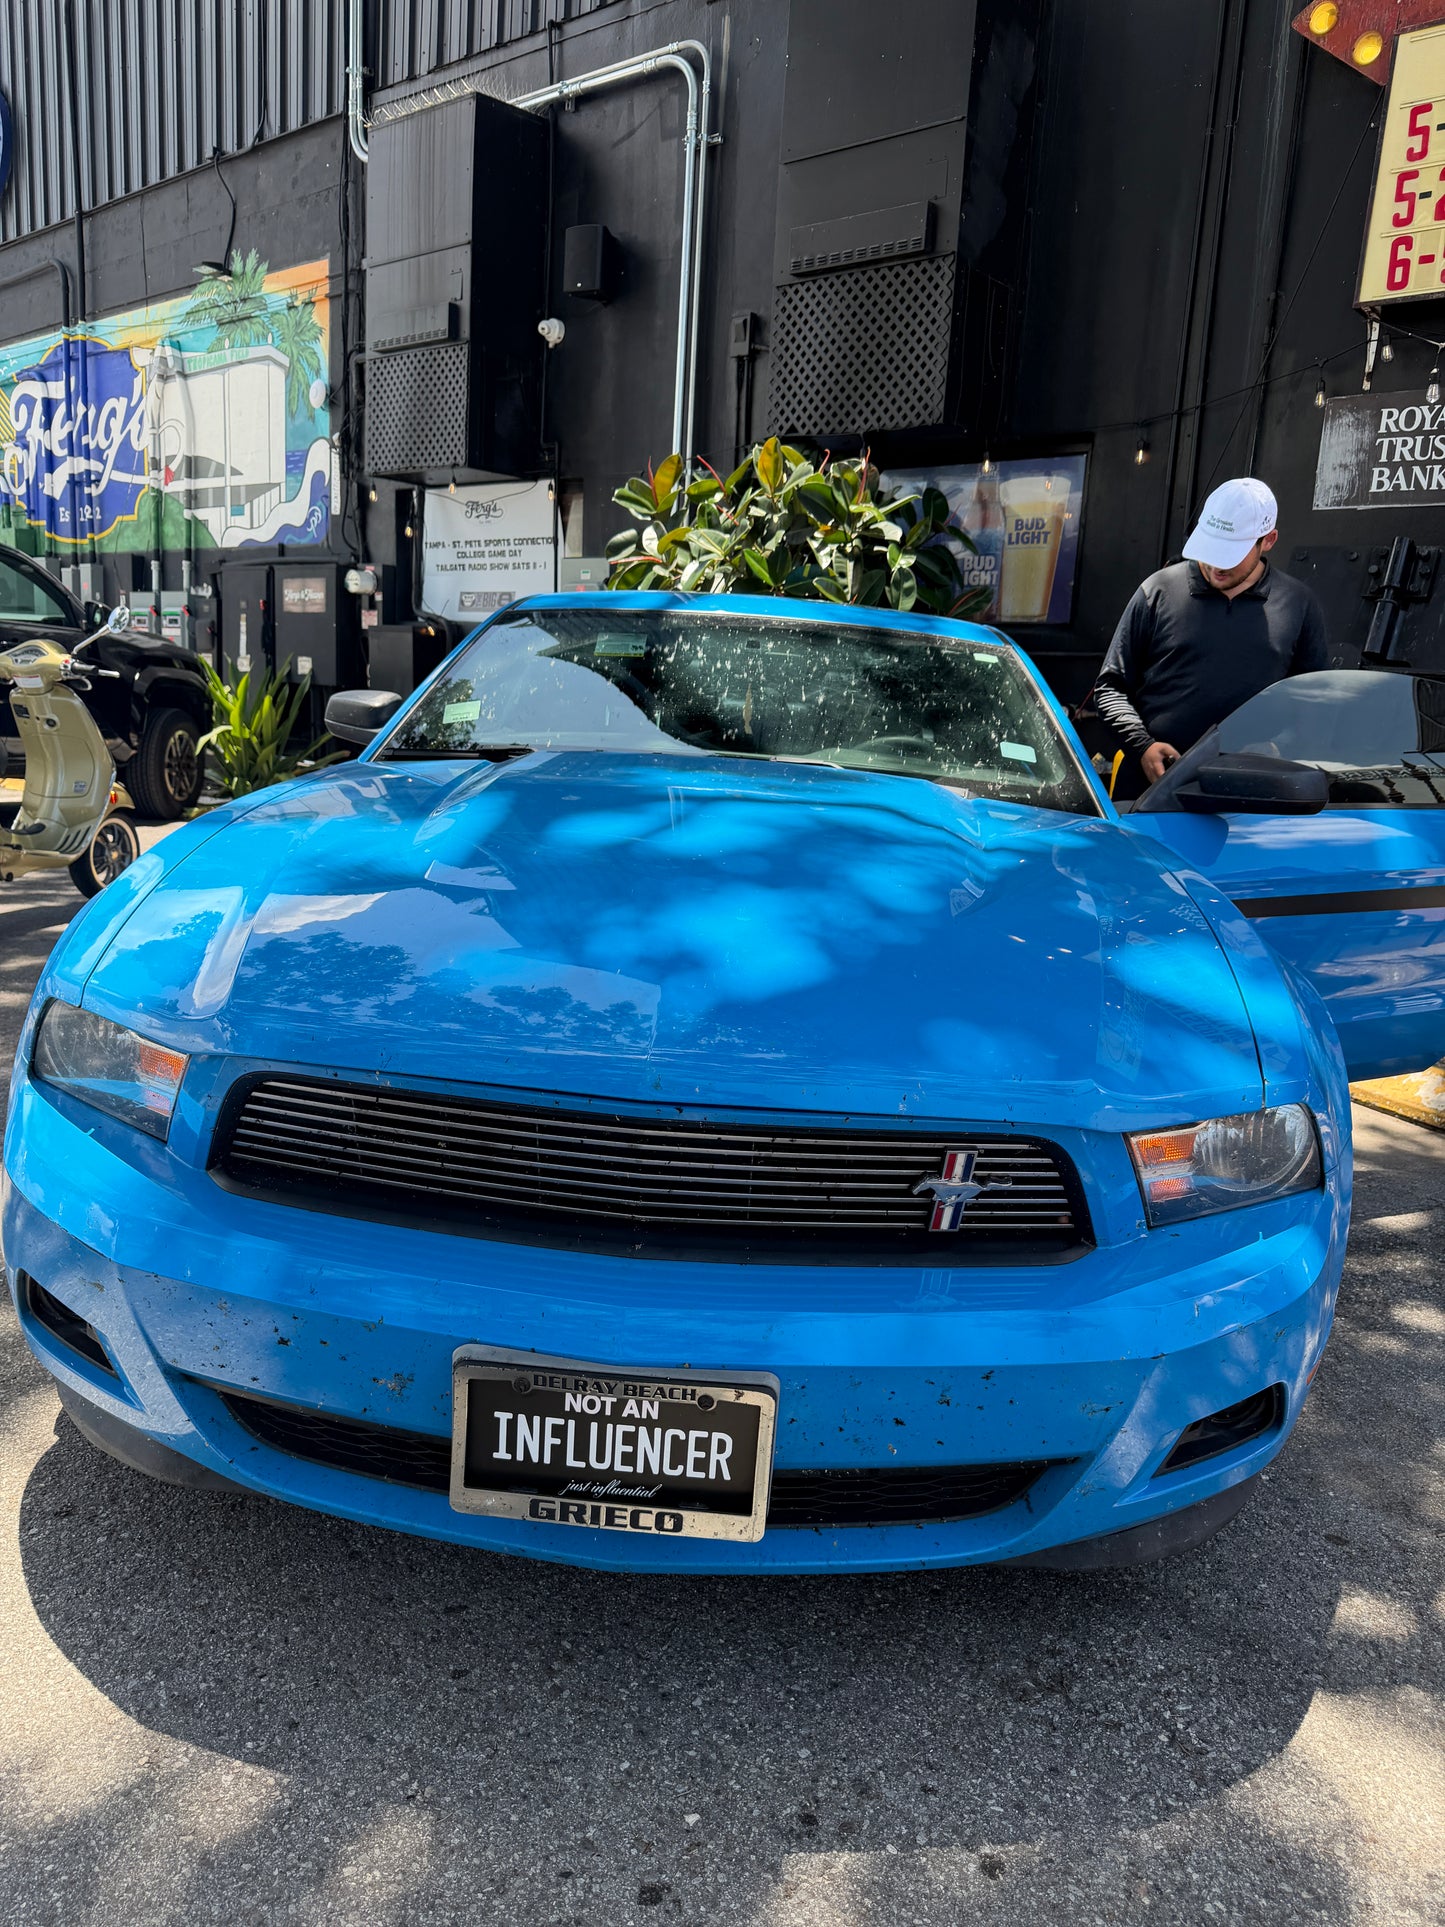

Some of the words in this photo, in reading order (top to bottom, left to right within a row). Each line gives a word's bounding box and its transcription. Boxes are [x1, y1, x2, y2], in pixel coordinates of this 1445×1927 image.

[1386, 235, 1445, 291] 6-
[1369, 464, 1445, 493] BANK
[465, 500, 504, 519] Ferg's
[1014, 517, 1046, 531] BUD
[425, 541, 446, 549] TAMPA
[465, 539, 481, 547] PETE
[484, 538, 511, 547] SPORTS
[1007, 531, 1051, 546] LIGHT
[456, 550, 486, 559] COLLEGE
[488, 550, 507, 558] GAME
[508, 549, 522, 558] DAY
[963, 555, 996, 570] BUD
[436, 563, 466, 572] TAILGATE
[468, 563, 487, 571] RADIO
[489, 562, 510, 571] SHOW
[512, 562, 530, 570] SATS
[963, 570, 998, 586] IGHT
[533, 1374, 618, 1395] DELRAY
[623, 1384, 697, 1401] BEACH
[564, 1392, 617, 1416] NOT
[621, 1398, 660, 1420] AN
[492, 1410, 733, 1481] INFLUENCER
[557, 1479, 591, 1496] just
[590, 1479, 663, 1498] influential
[529, 1498, 683, 1533] GRIECO
